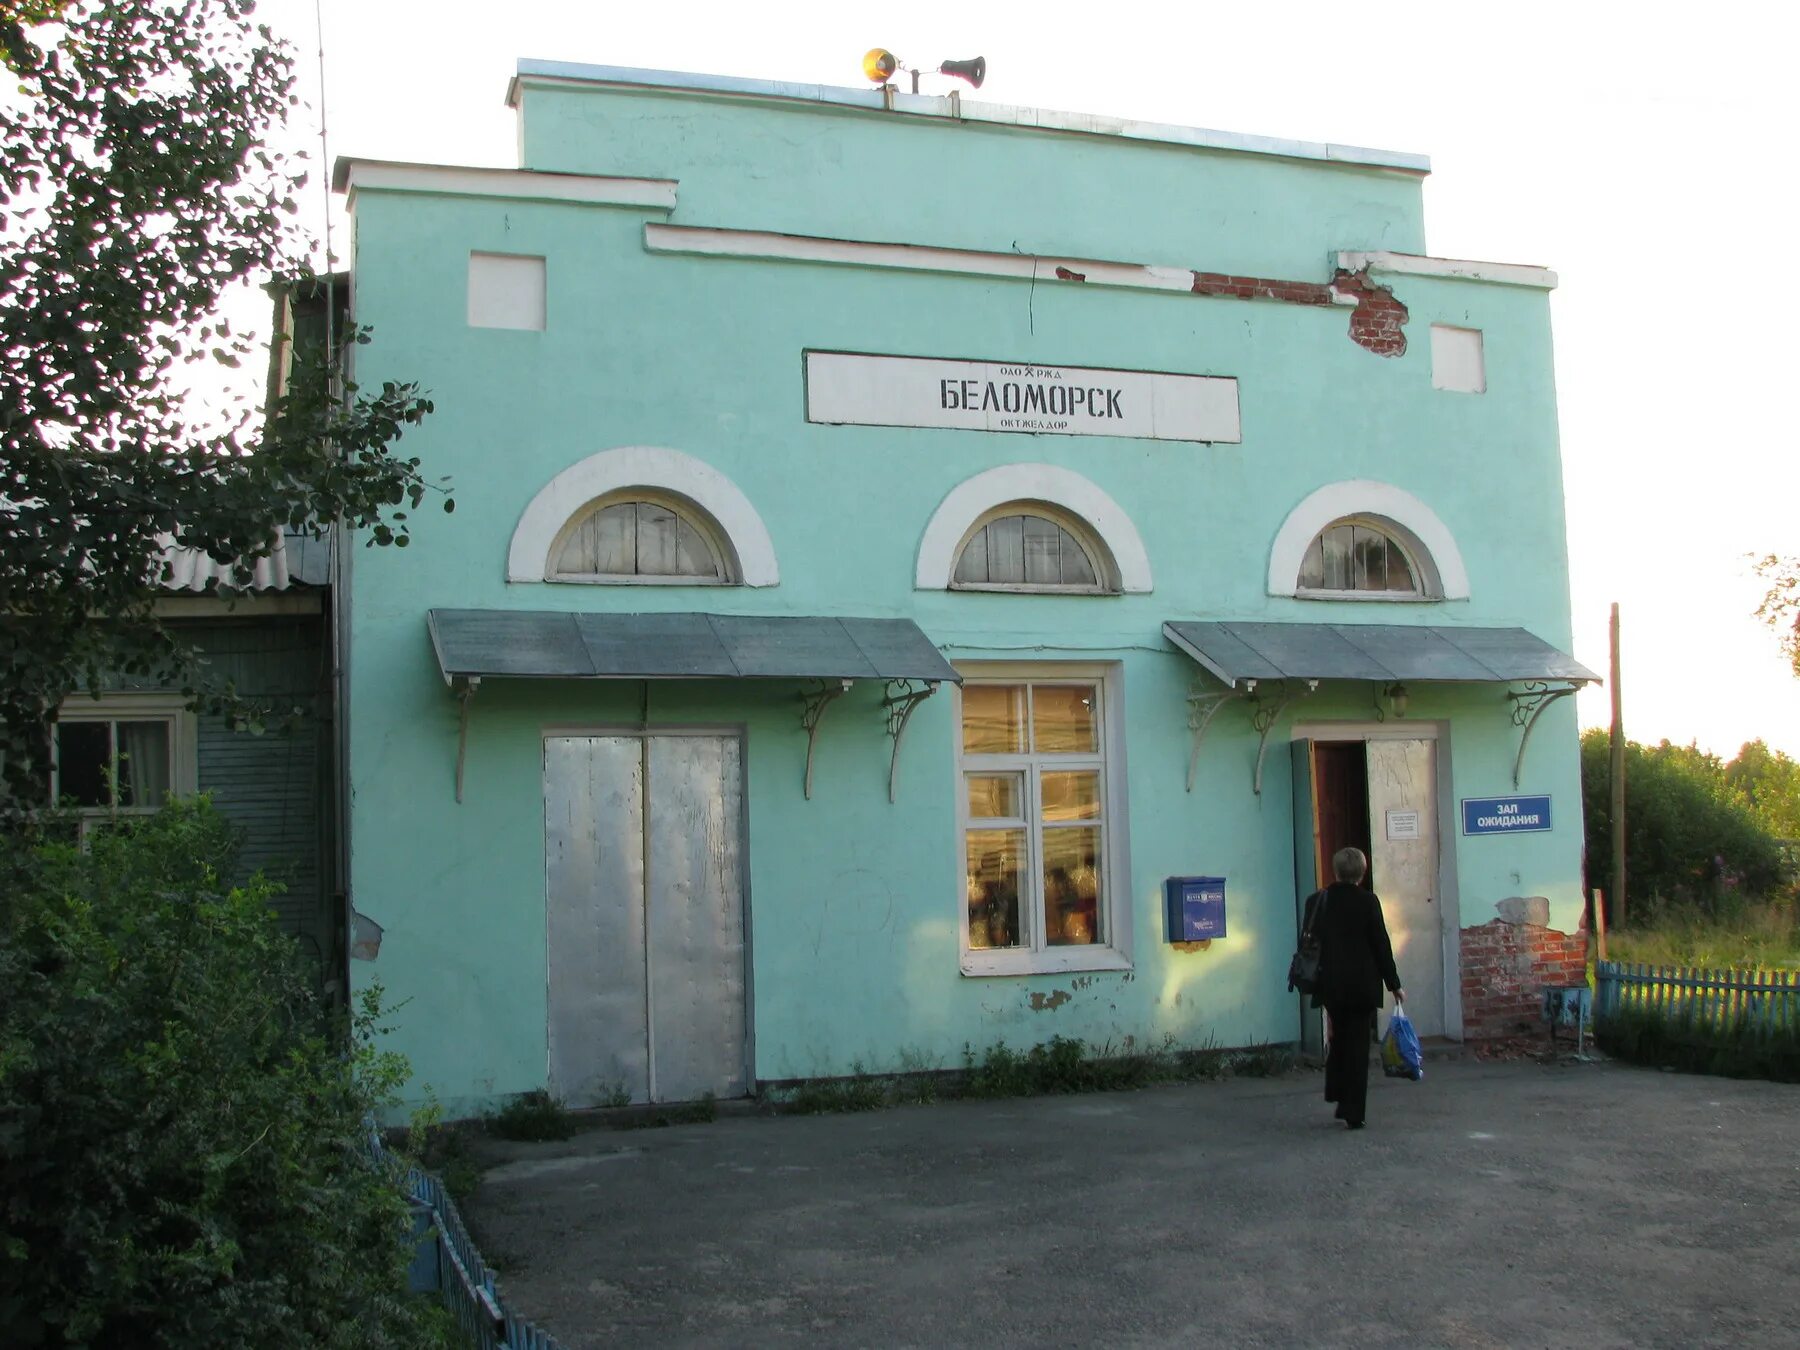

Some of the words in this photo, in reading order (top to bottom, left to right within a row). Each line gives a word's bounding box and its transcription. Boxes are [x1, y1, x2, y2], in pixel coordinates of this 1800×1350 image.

[1000, 367, 1021, 376] ОАО
[1036, 369, 1062, 379] РЖД
[940, 379, 1123, 419] БЕЛОМОРСК
[1496, 804, 1518, 815] ЗАЛ
[1477, 815, 1539, 828] ОЖИДАНИЯ
